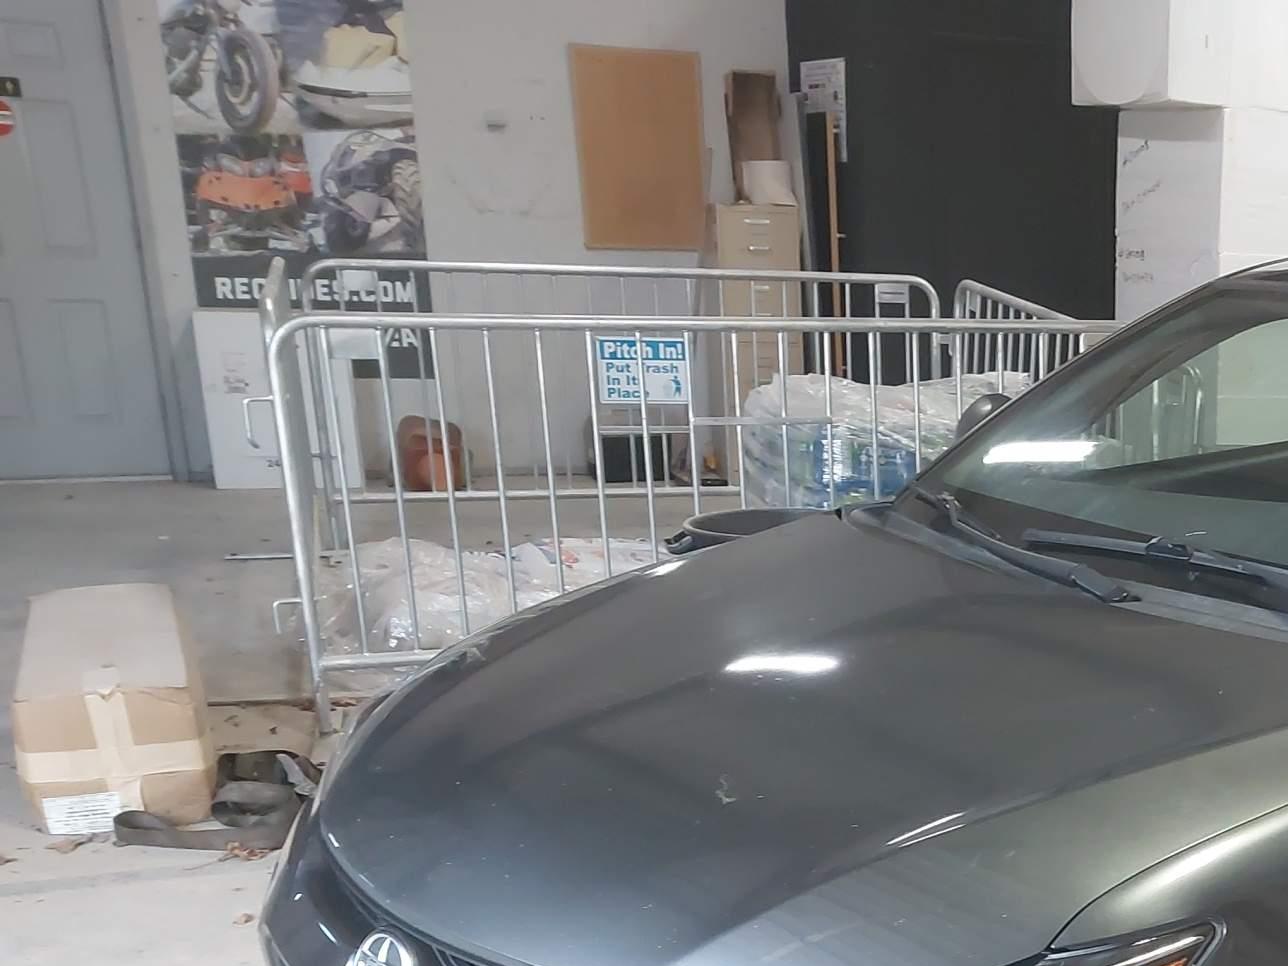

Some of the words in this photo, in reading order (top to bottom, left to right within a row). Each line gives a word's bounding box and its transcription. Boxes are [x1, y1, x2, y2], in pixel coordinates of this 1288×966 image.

[658, 342, 683, 359] In!
[606, 362, 631, 373] Put
[636, 362, 679, 374] rash
[607, 375, 620, 386] In
